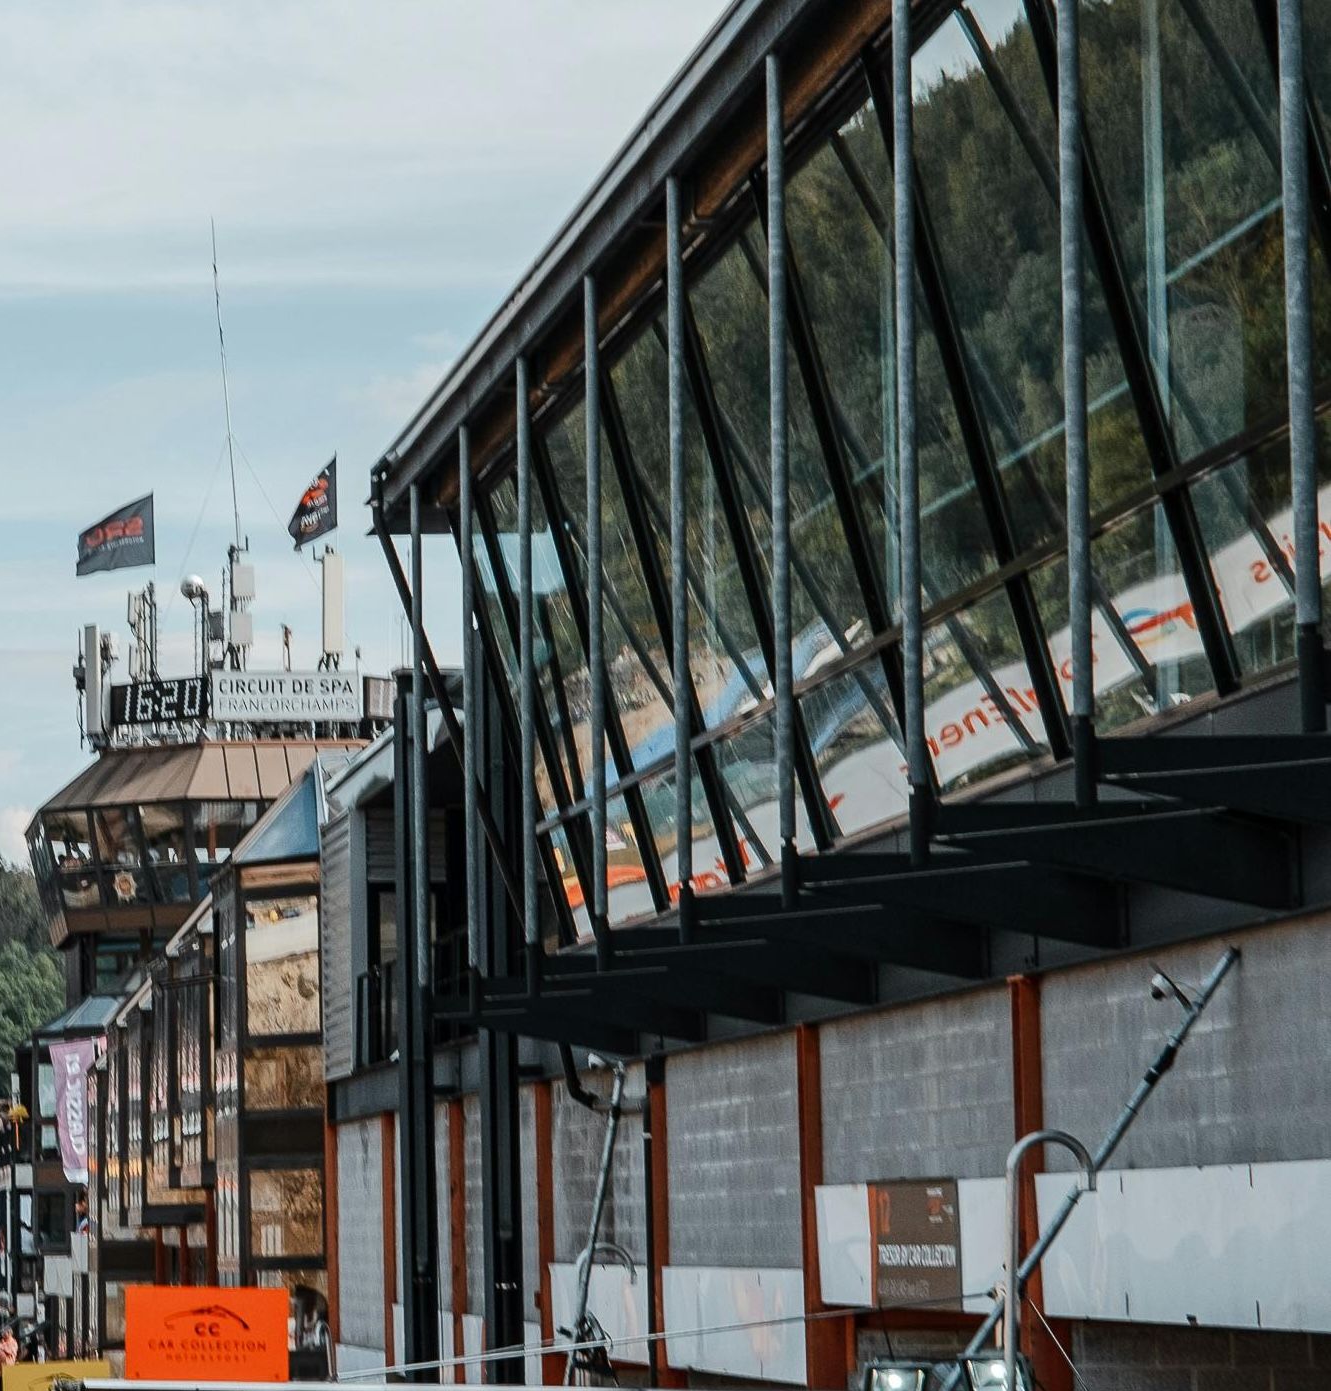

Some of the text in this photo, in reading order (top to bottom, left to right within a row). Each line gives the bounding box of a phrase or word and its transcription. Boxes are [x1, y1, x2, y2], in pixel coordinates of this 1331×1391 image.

[218, 678, 354, 696] CIRCUIT DE SPA
[125, 679, 201, 722] 16:20
[218, 697, 356, 714] FRANCORCHAMPS
[194, 1322, 220, 1336] CC
[148, 1339, 267, 1352] CAR COLLECTION
